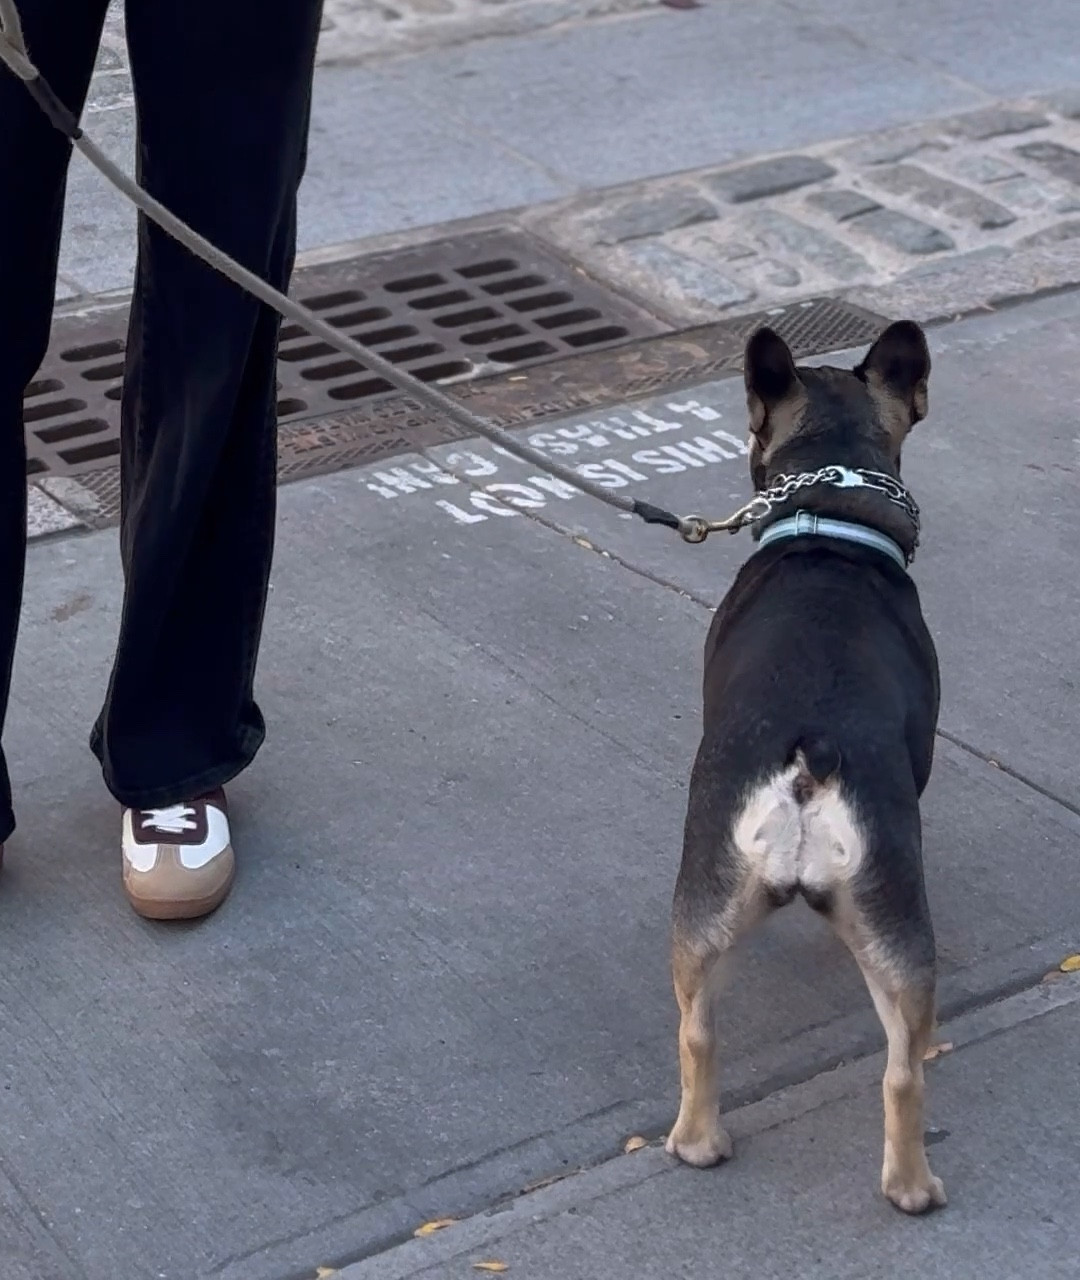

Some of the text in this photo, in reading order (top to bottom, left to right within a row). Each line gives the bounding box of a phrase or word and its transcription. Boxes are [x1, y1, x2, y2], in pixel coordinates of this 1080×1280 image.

[666, 399, 722, 421] A
[435, 430, 750, 524] THIS IS NOT
